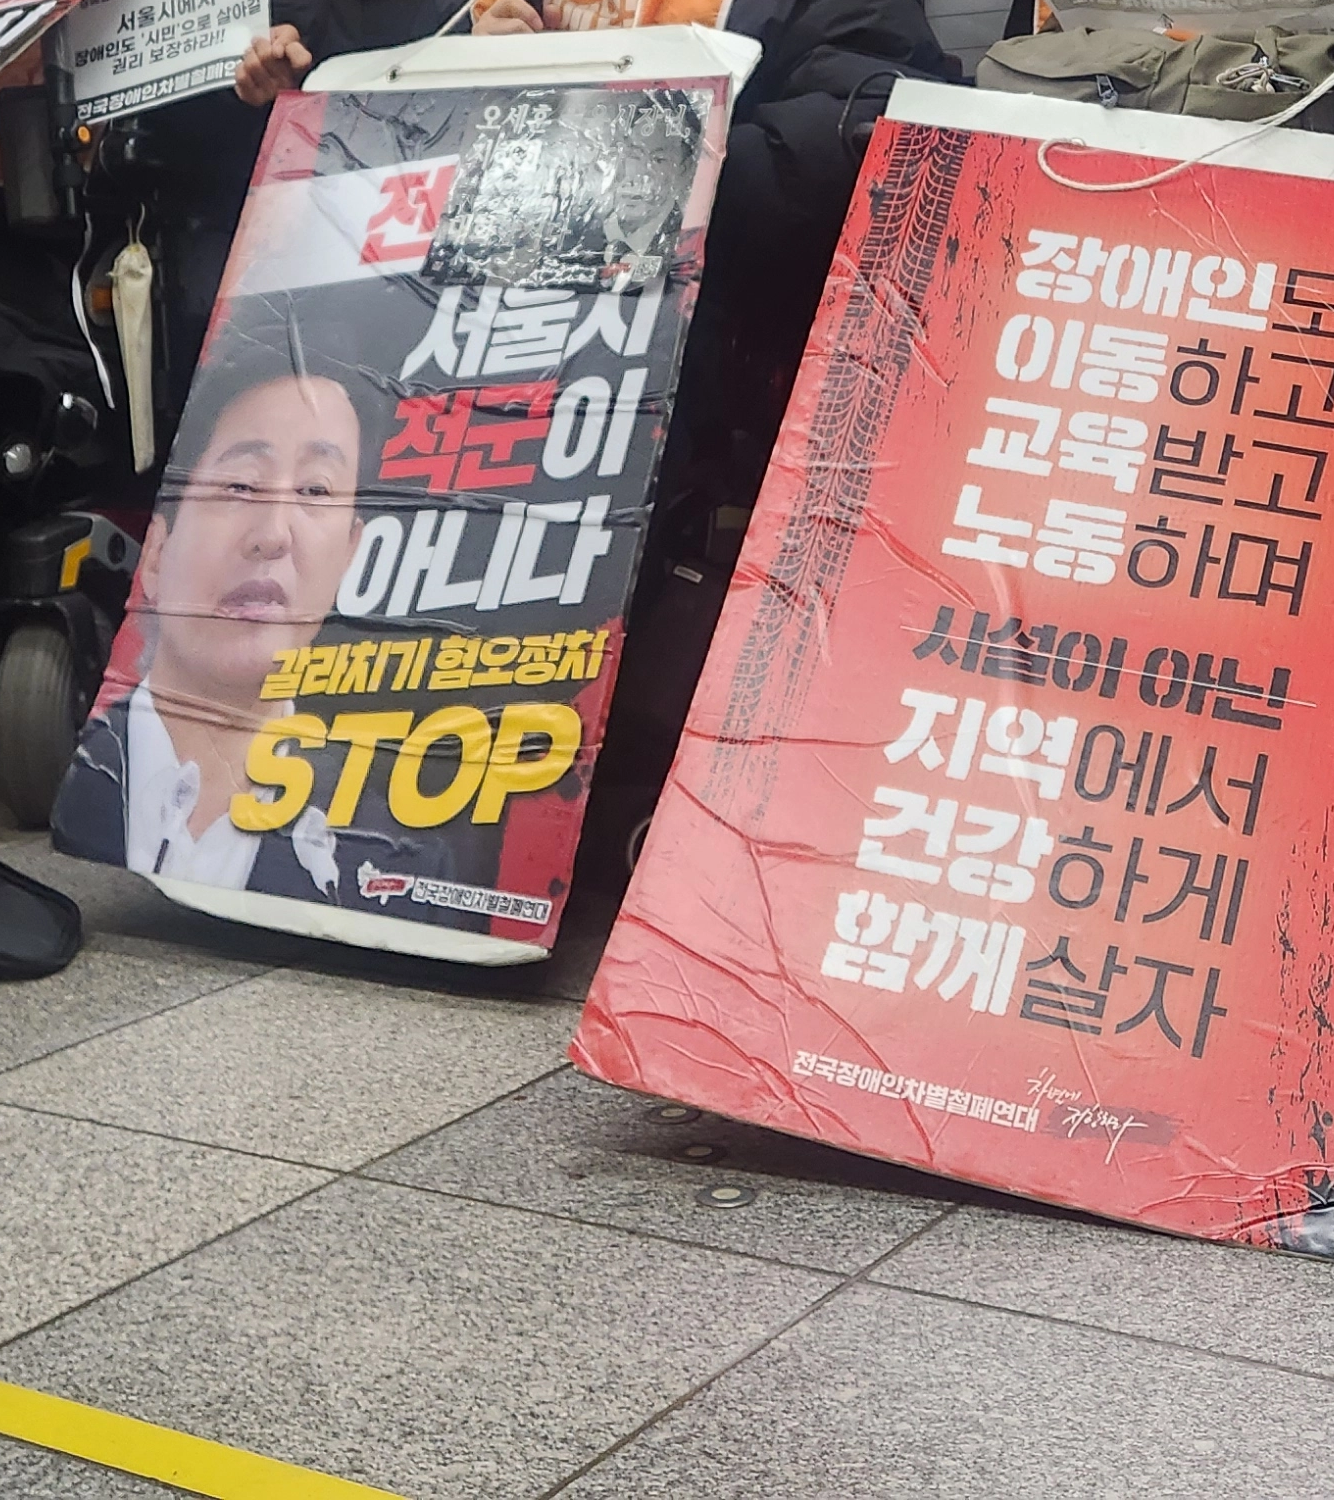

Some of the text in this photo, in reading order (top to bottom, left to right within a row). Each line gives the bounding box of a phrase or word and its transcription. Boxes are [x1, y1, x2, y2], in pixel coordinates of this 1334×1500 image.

[75, 35, 136, 67] 장애인도
[141, 16, 212, 48] '시민'으로
[77, 60, 243, 119] 전국장애인차별철폐연
[111, 30, 225, 75] 권리 보장하라!!
[475, 103, 553, 135] 오세훈
[400, 281, 664, 381] 서울시
[378, 368, 649, 494] 적군이
[967, 397, 1329, 521] 교육받고
[336, 496, 612, 618] 아니다
[942, 484, 1313, 617] 노동하며
[259, 629, 610, 702] 갈라치기 혐오정치
[912, 607, 1292, 731] 시설이 아닌
[230, 703, 581, 832] STOP
[884, 689, 1270, 837] 지역에서
[856, 786, 1248, 946] 건강하게
[792, 1050, 1040, 1133] 전국장애인차별철폐연대
